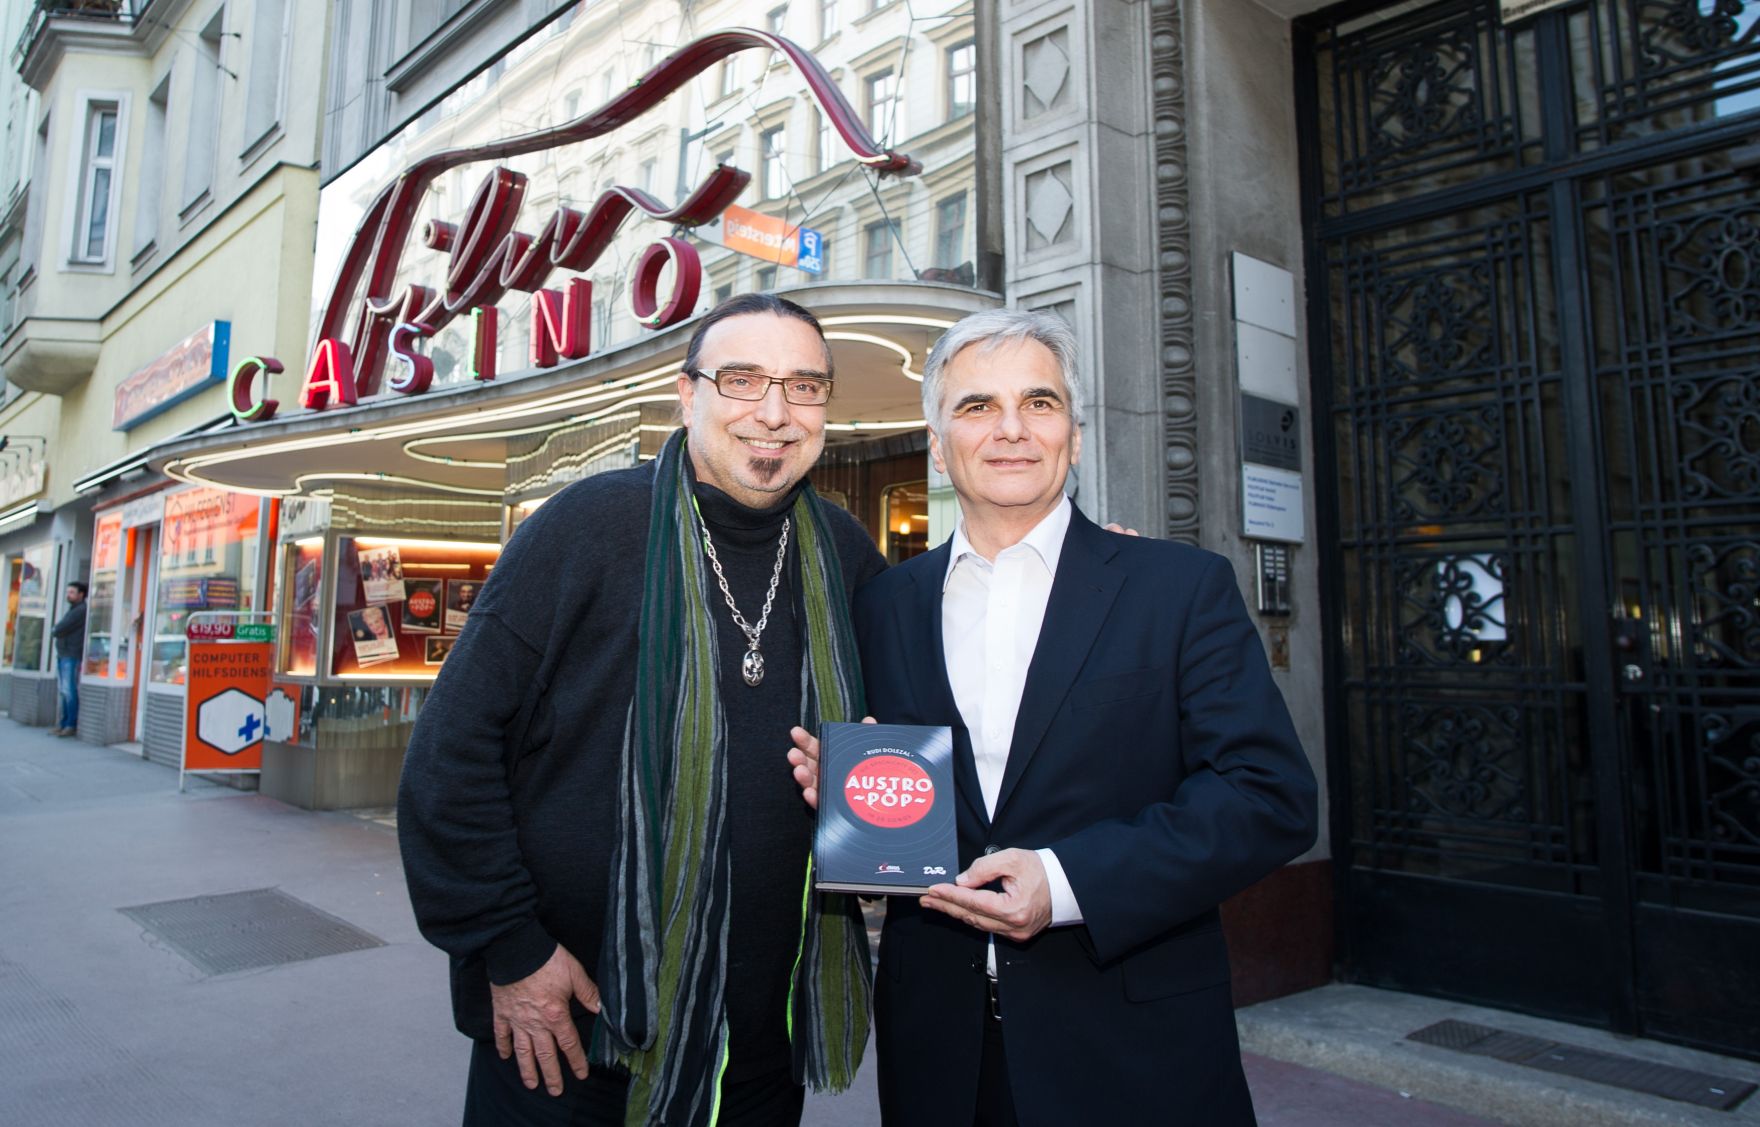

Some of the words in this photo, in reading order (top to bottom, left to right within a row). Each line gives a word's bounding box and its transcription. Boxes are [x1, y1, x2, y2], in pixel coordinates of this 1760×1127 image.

[227, 236, 701, 422] CASINO
[237, 624, 266, 636] Gratis
[193, 652, 260, 664] COMPUTER
[845, 775, 933, 792] AUSTRO
